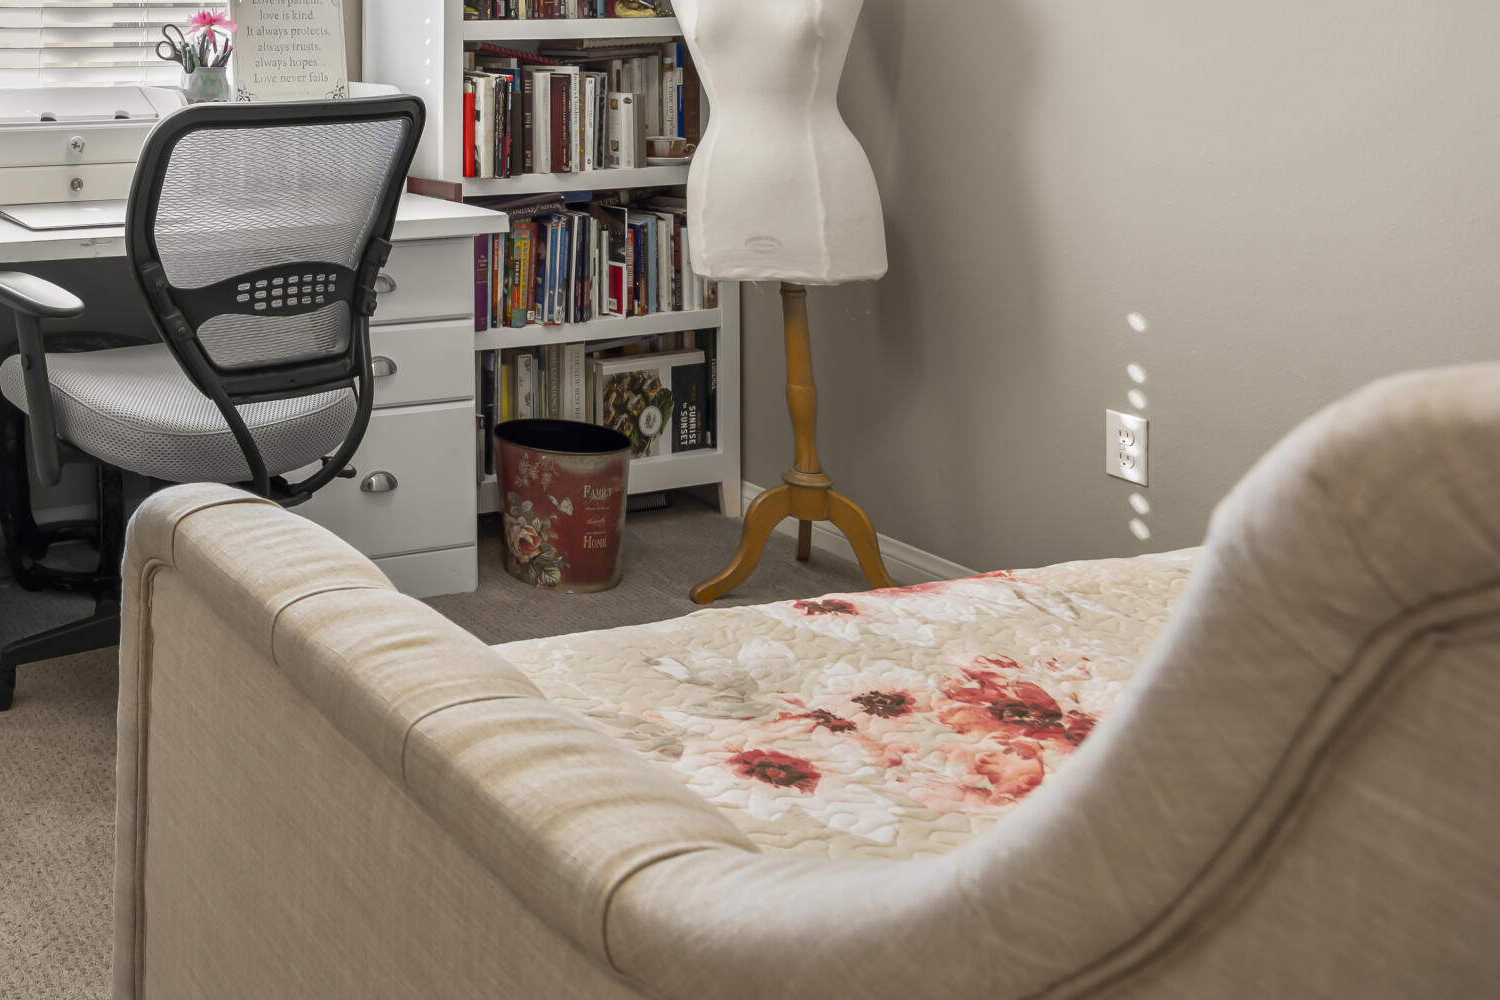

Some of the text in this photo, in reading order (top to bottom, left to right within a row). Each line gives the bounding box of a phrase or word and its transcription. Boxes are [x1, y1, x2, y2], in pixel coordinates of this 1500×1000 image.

[260, 10, 279, 20] love
[282, 11, 290, 20] is
[247, 26, 253, 36] It
[256, 26, 288, 37] always
[258, 42, 289, 54] always
[255, 58, 287, 69] always
[253, 72, 328, 83] Love never fails
[583, 485, 612, 498] FAMILY
[583, 535, 607, 548] HOME
